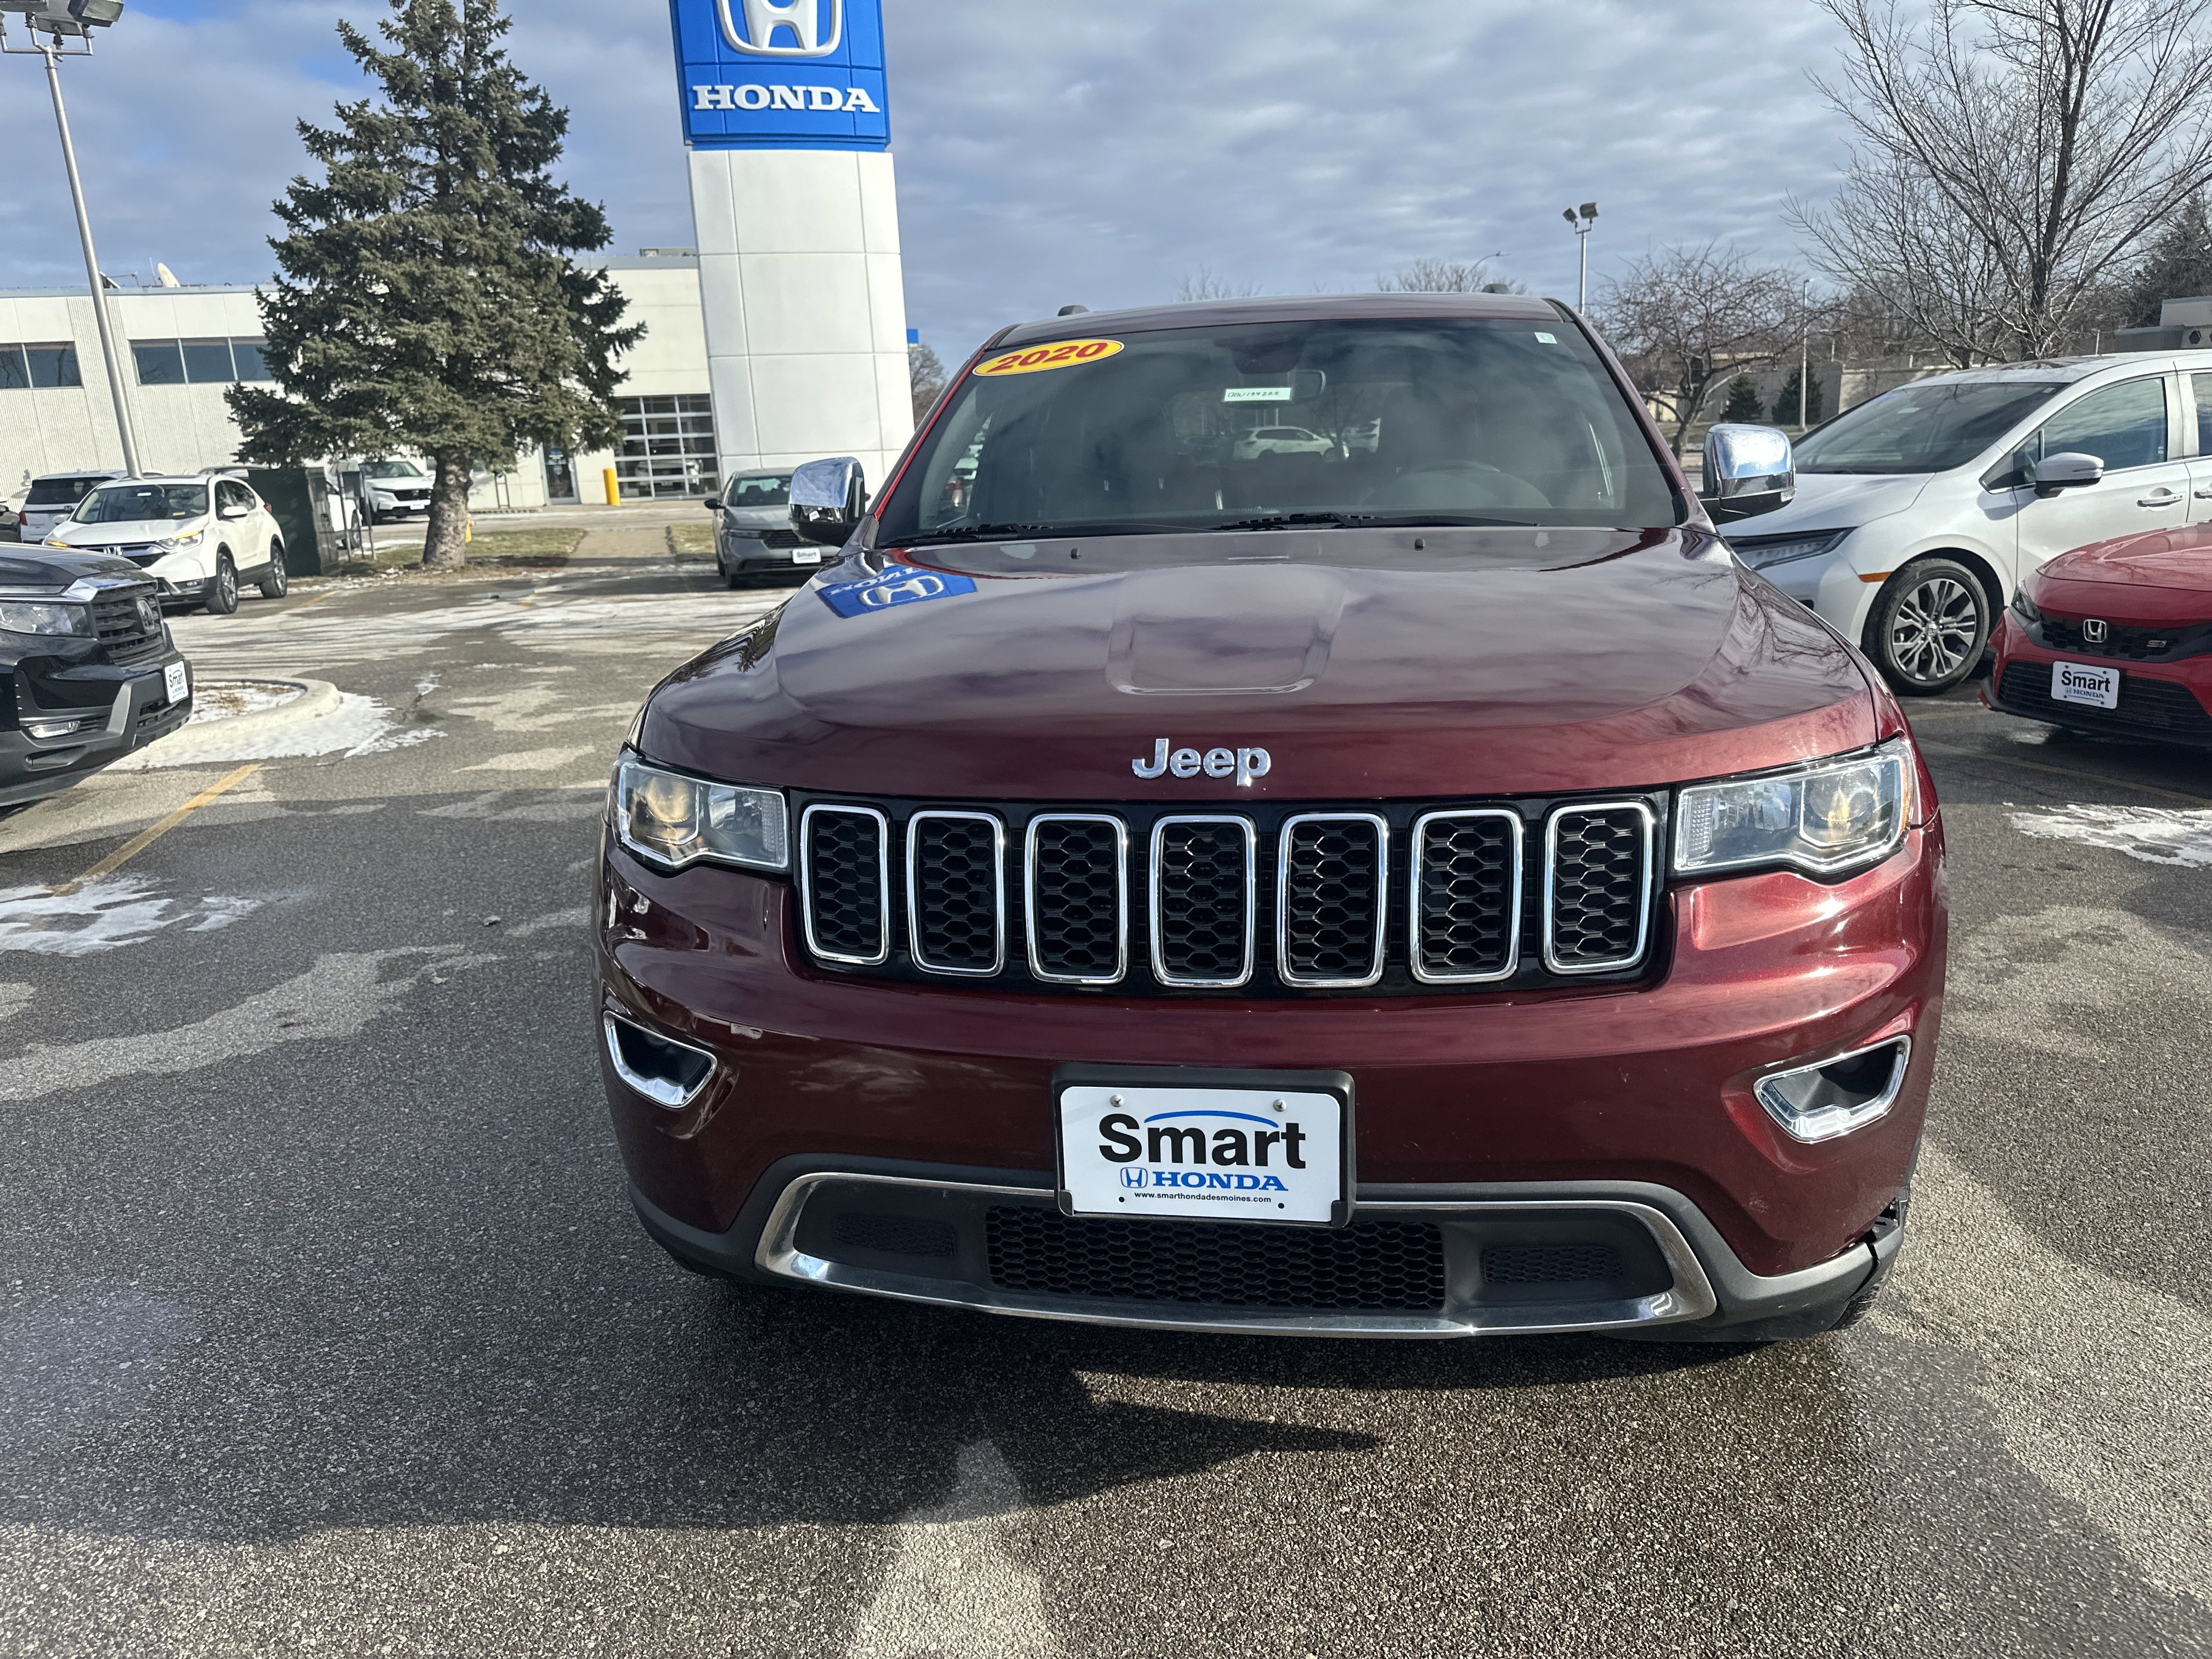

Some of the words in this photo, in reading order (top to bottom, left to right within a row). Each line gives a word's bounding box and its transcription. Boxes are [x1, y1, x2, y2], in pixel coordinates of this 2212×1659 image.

[692, 84, 880, 113] HONDA
[986, 342, 1108, 373] 2020
[2061, 670, 2111, 692] Smart
[2073, 689, 2104, 699] HONDA
[1132, 738, 1271, 787] Jeep
[1098, 1113, 1306, 1169] Smart
[1152, 1171, 1288, 1191] HONDA
[1134, 1192, 1271, 1203] www.smarthondadesmoines.com
